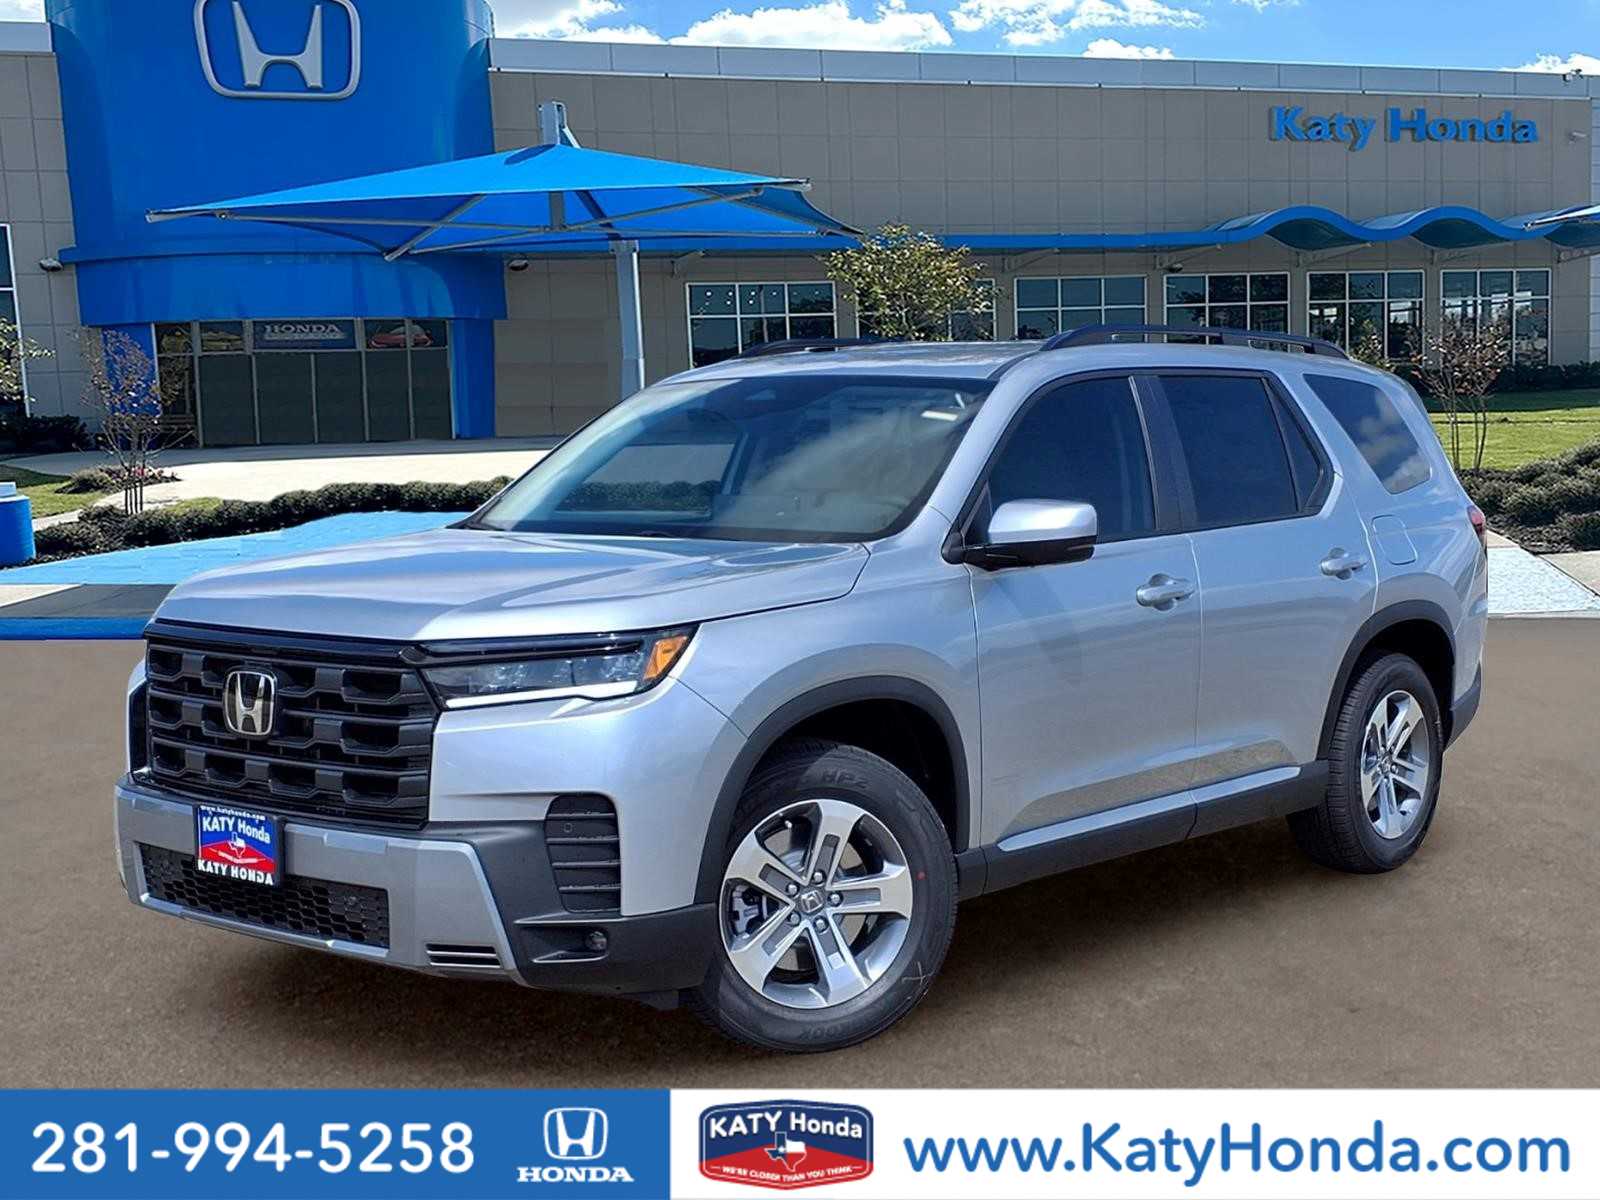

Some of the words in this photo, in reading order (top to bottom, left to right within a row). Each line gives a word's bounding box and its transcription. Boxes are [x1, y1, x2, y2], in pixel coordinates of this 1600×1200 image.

[1269, 105, 1376, 151] Katy
[1384, 106, 1539, 143] Honda
[264, 323, 342, 336] HONDA
[202, 816, 235, 832] KATY
[237, 818, 271, 844] Honda
[197, 859, 228, 876] KATY
[230, 865, 274, 886] HONDA
